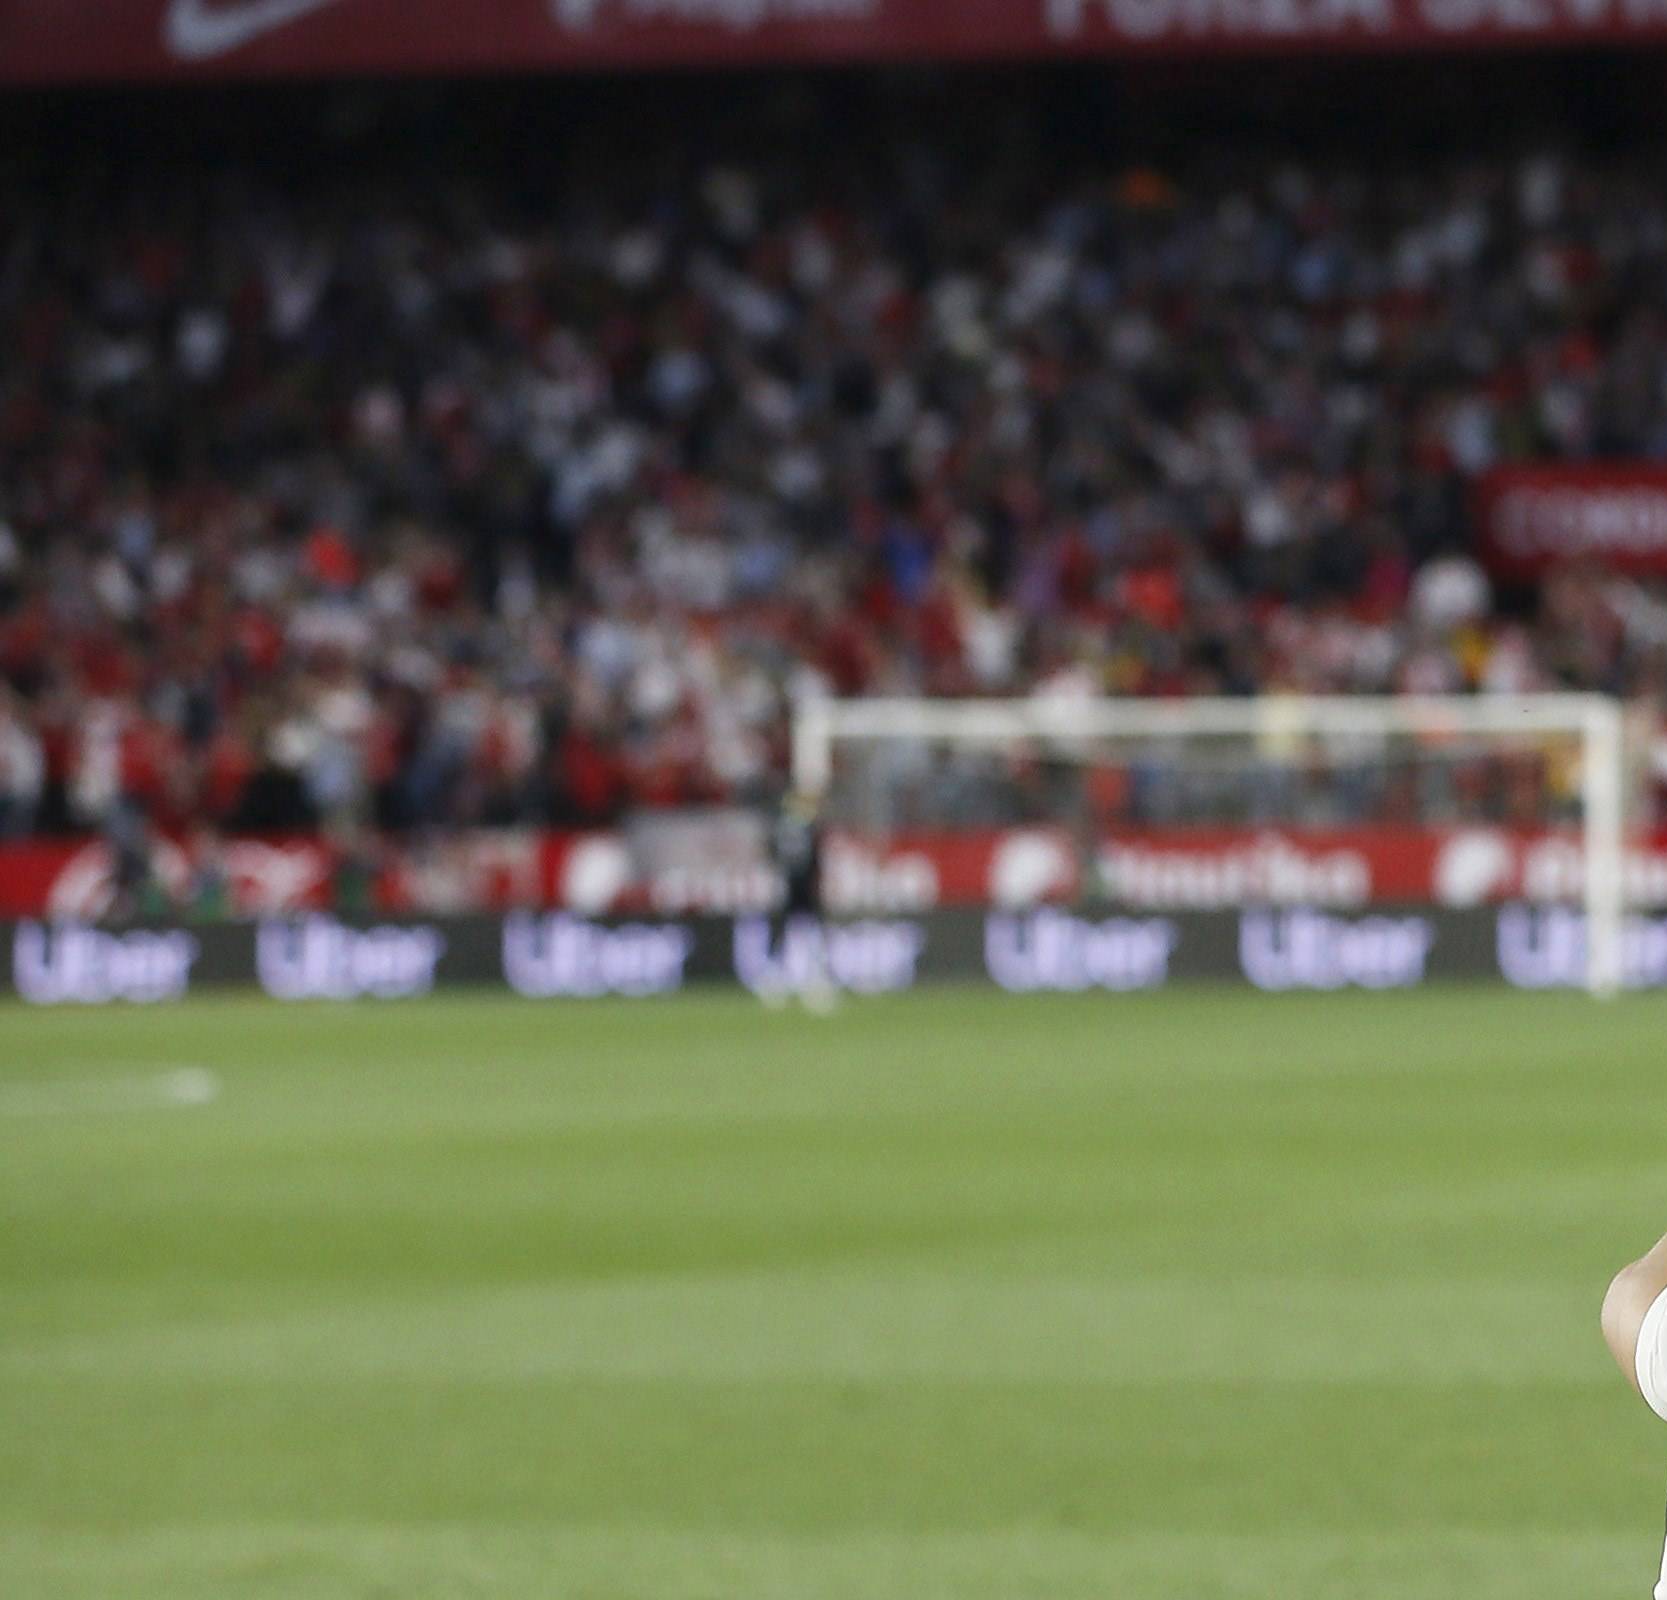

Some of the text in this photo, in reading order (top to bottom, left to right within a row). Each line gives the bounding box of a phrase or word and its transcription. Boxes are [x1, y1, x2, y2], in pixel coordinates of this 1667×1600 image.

[255, 912, 445, 1000] Uber
[502, 912, 693, 996] Uber
[985, 907, 1174, 990] Uber
[1239, 907, 1433, 990] Uber
